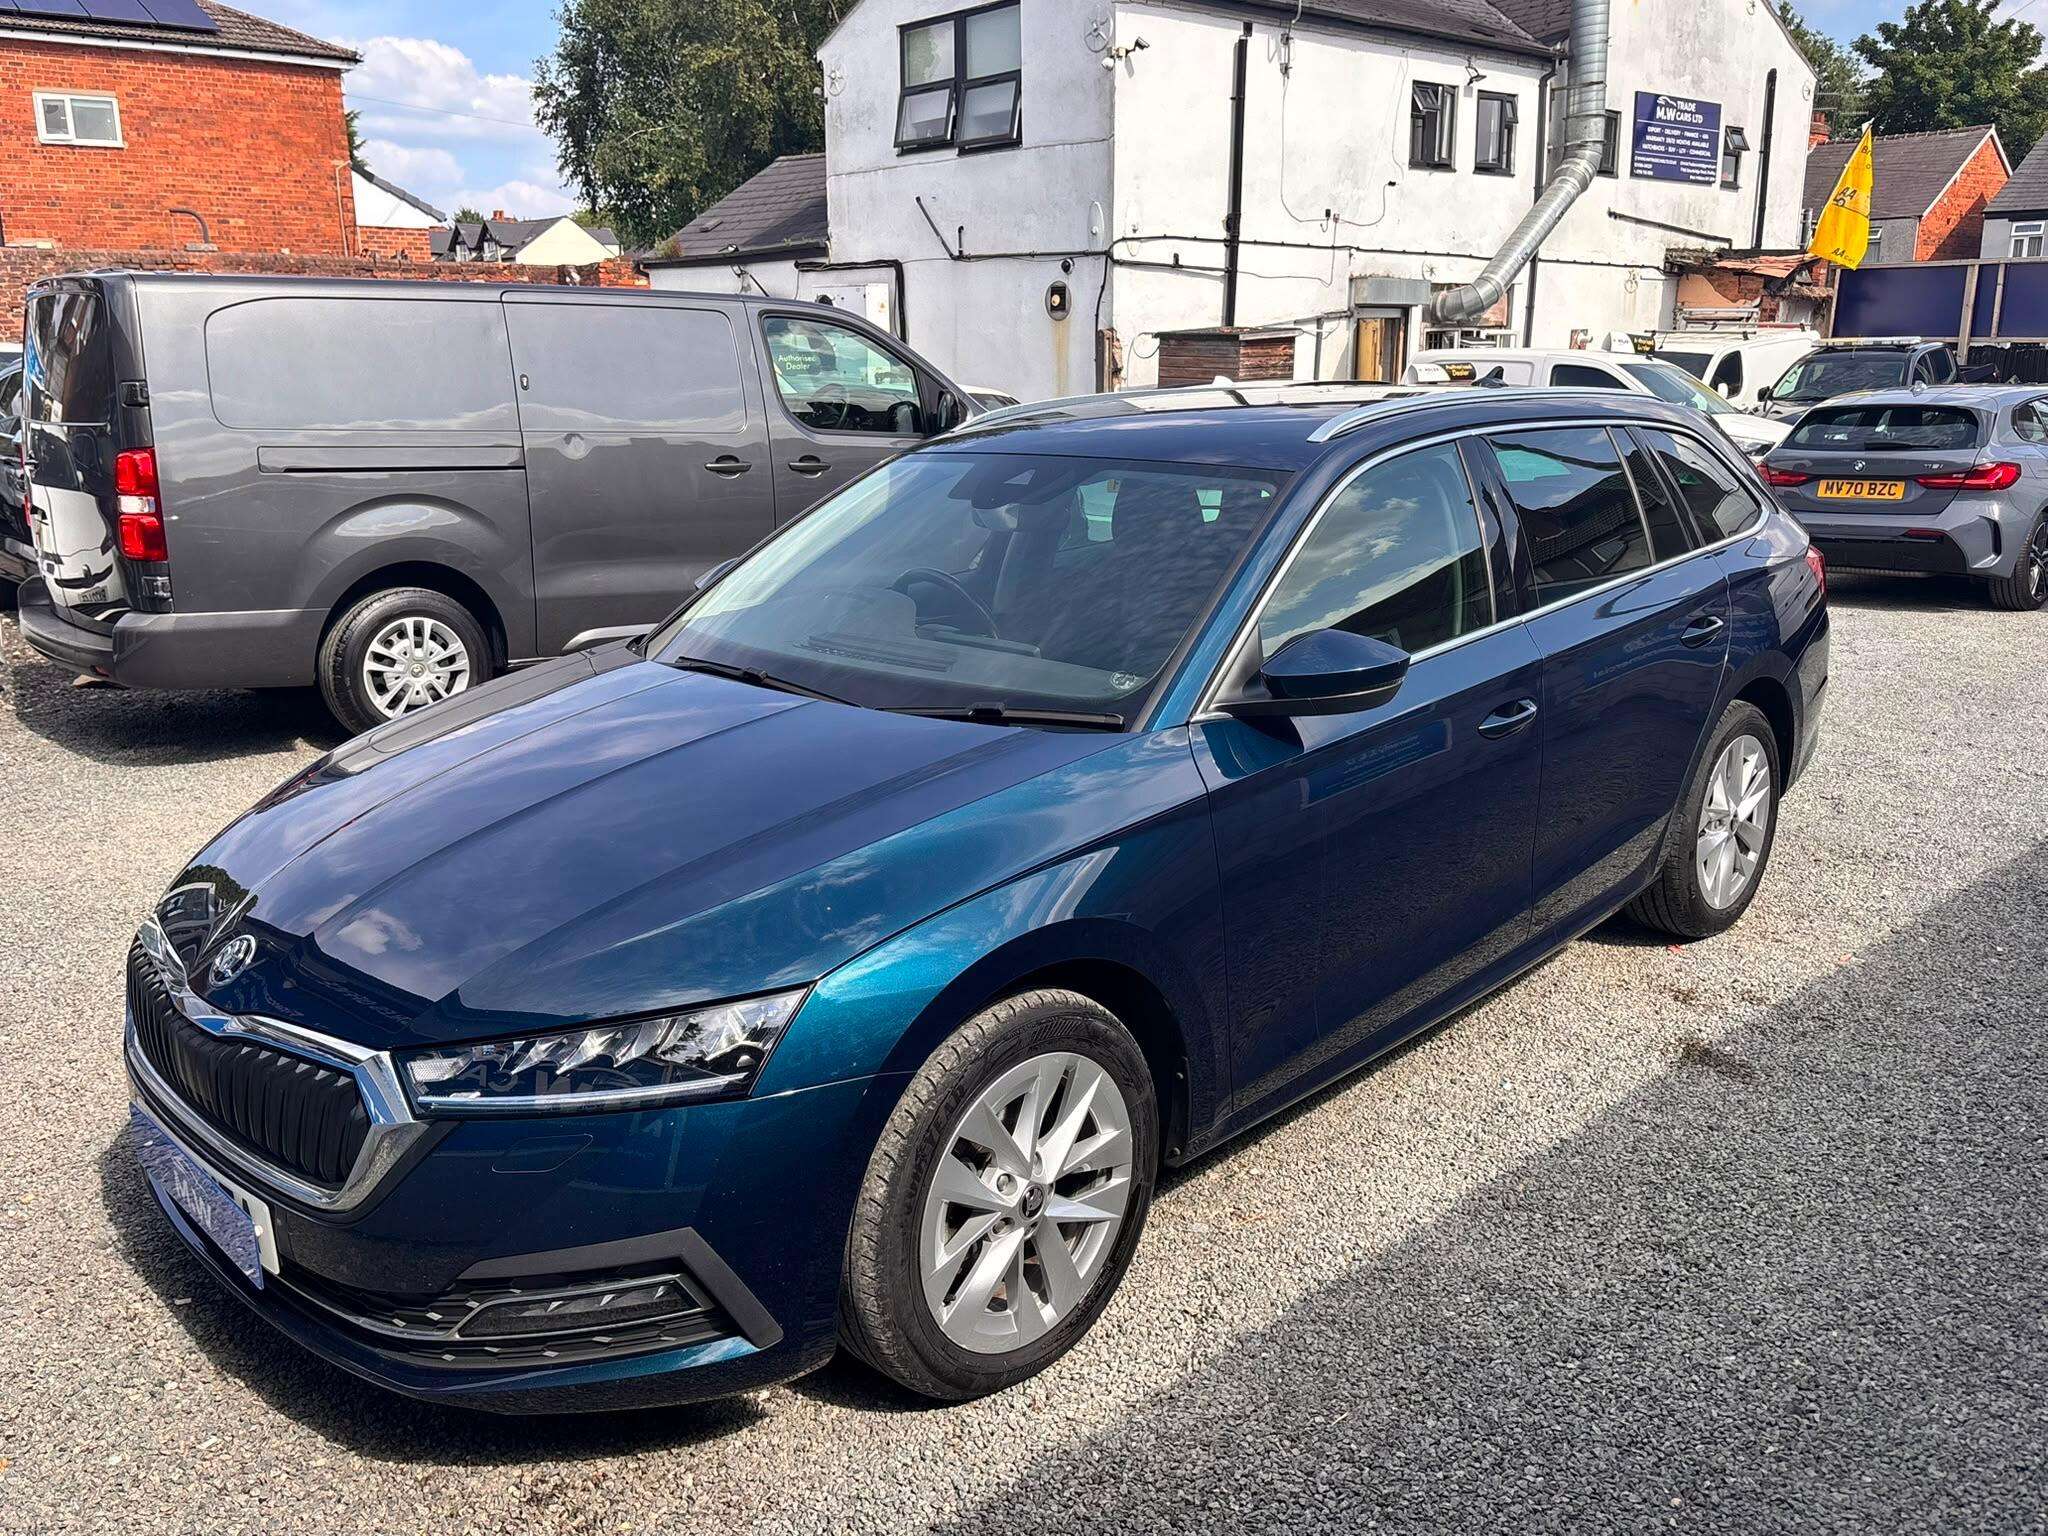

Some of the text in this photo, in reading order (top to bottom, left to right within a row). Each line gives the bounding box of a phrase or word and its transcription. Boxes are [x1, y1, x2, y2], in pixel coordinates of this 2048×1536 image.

[1677, 101, 1696, 111] TRADE
[1656, 107, 1703, 123] M.W CARS LTD
[778, 354, 817, 362] Authorised
[786, 362, 811, 370] Dealer
[1824, 480, 1899, 497] MV70 BZC
